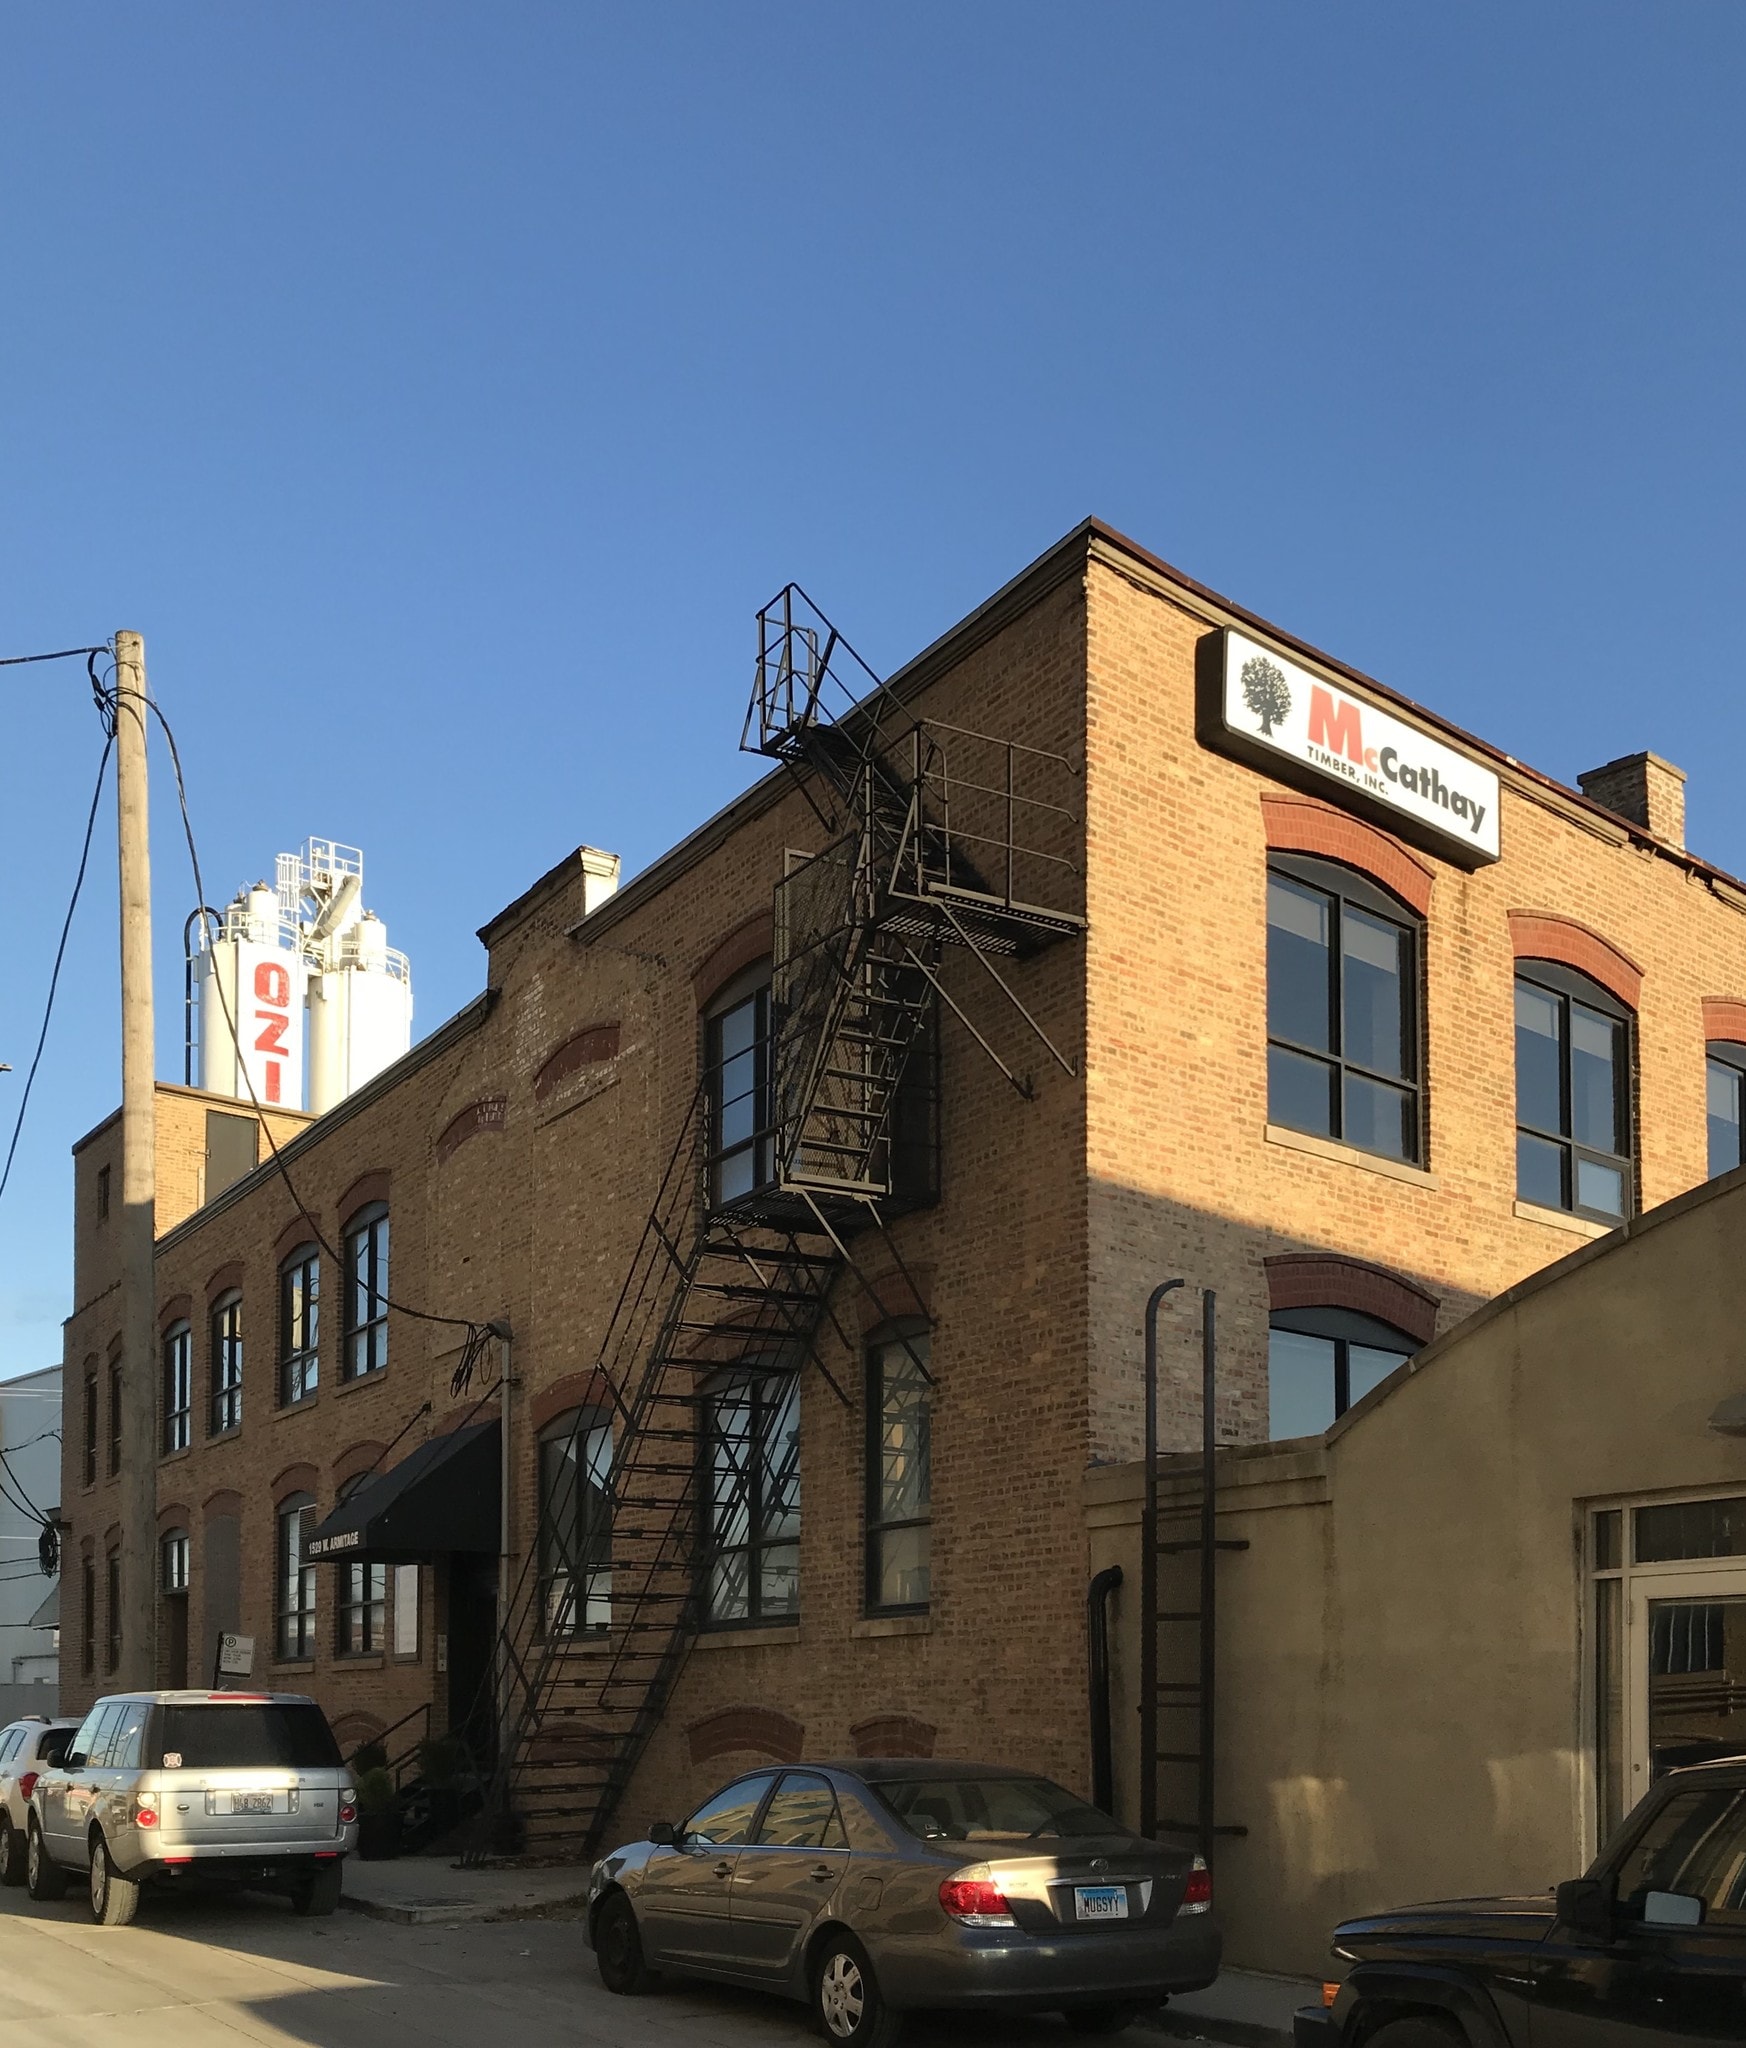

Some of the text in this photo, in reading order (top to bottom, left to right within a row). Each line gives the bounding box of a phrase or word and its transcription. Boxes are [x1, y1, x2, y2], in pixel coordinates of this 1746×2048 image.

[1307, 683, 1486, 834] McCathay
[1307, 745, 1389, 796] TIMBER, INC.
[254, 961, 291, 1103] OZI
[330, 1531, 359, 1551] ARMITAGE
[1083, 1896, 1119, 1913] MUGSYY
